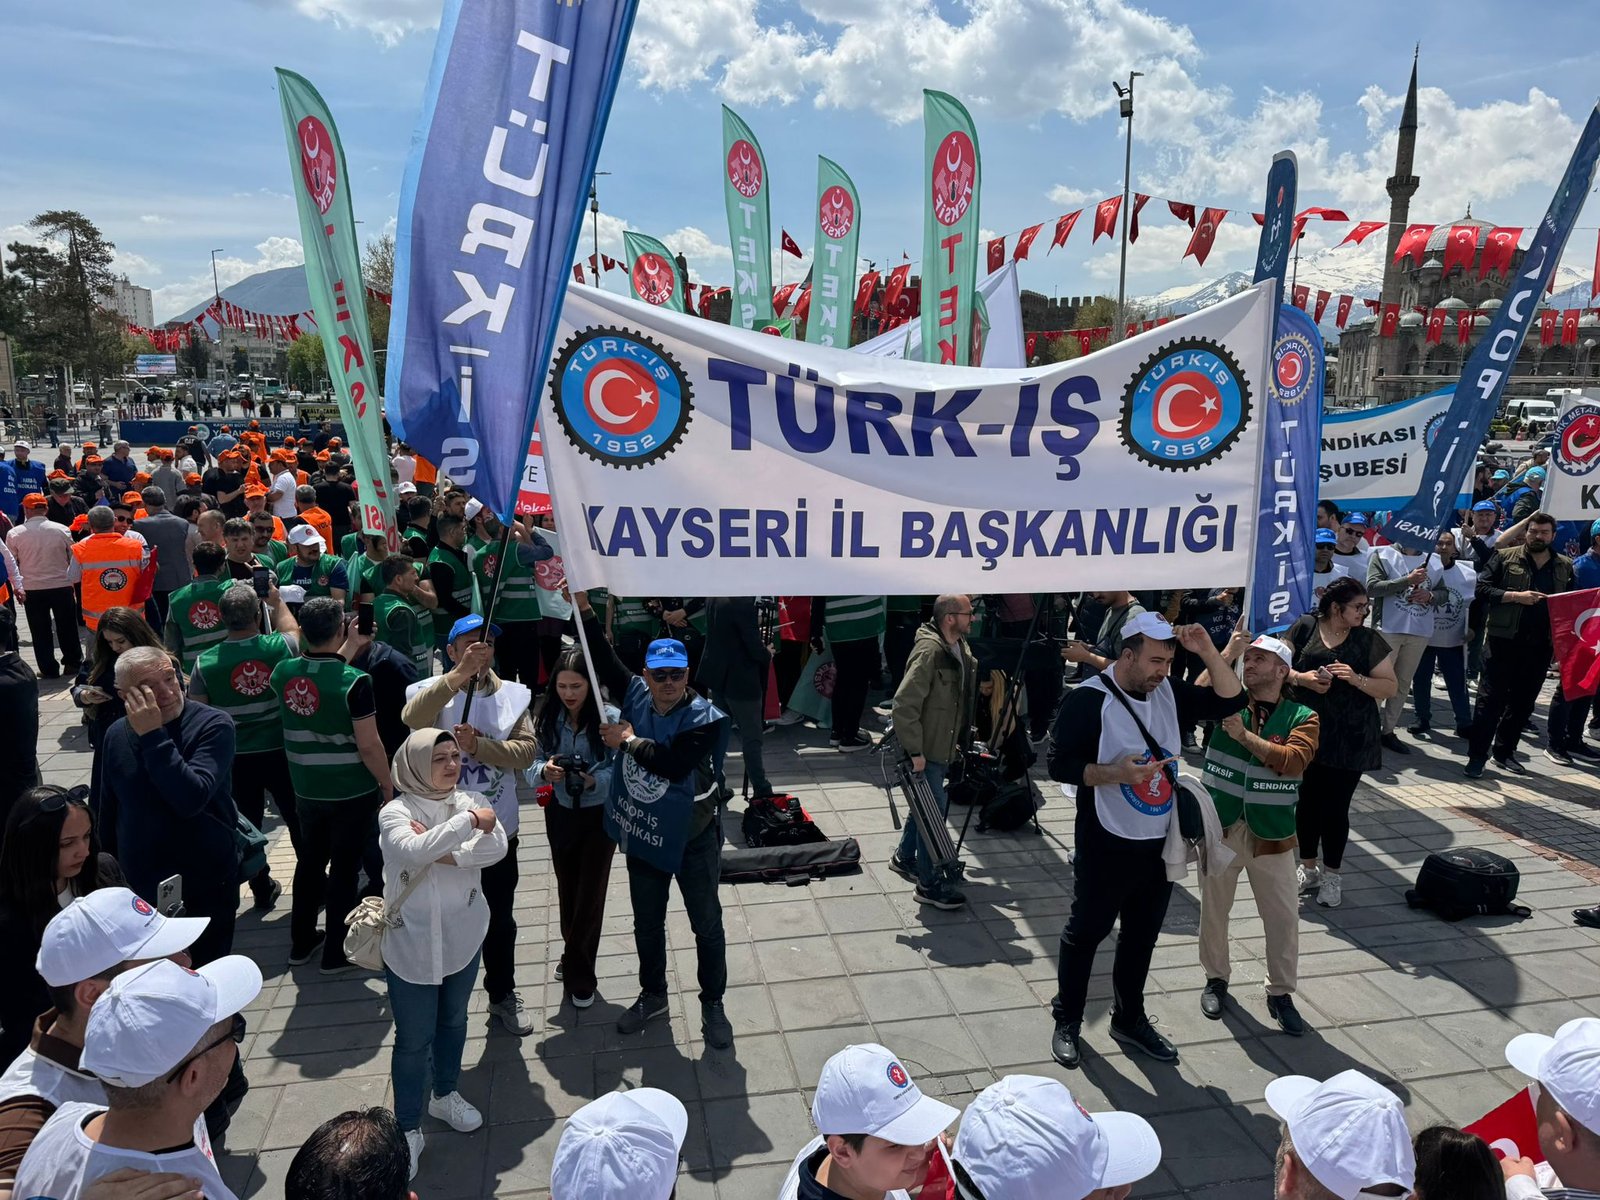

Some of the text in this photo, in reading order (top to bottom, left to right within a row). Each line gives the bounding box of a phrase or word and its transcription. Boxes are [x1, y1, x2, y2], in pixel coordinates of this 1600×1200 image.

[570, 339, 669, 382] TÜRK-İŞ
[1138, 352, 1229, 394] TÜRK-İŞ
[708, 357, 1102, 481] TÜRK-İŞ
[1568, 407, 1598, 421] METAL
[592, 433, 657, 453] 1952
[1152, 436, 1213, 457] 1952
[1321, 426, 1417, 451] NDİKASI
[1320, 453, 1408, 482] ŞUBESİ
[582, 493, 1238, 571] KAYSERİ İL BAŞKANLIĞI
[286, 697, 315, 716] TEKSF
[1207, 762, 1235, 778] TEKSİF
[617, 795, 659, 830] KOOP-İŞ
